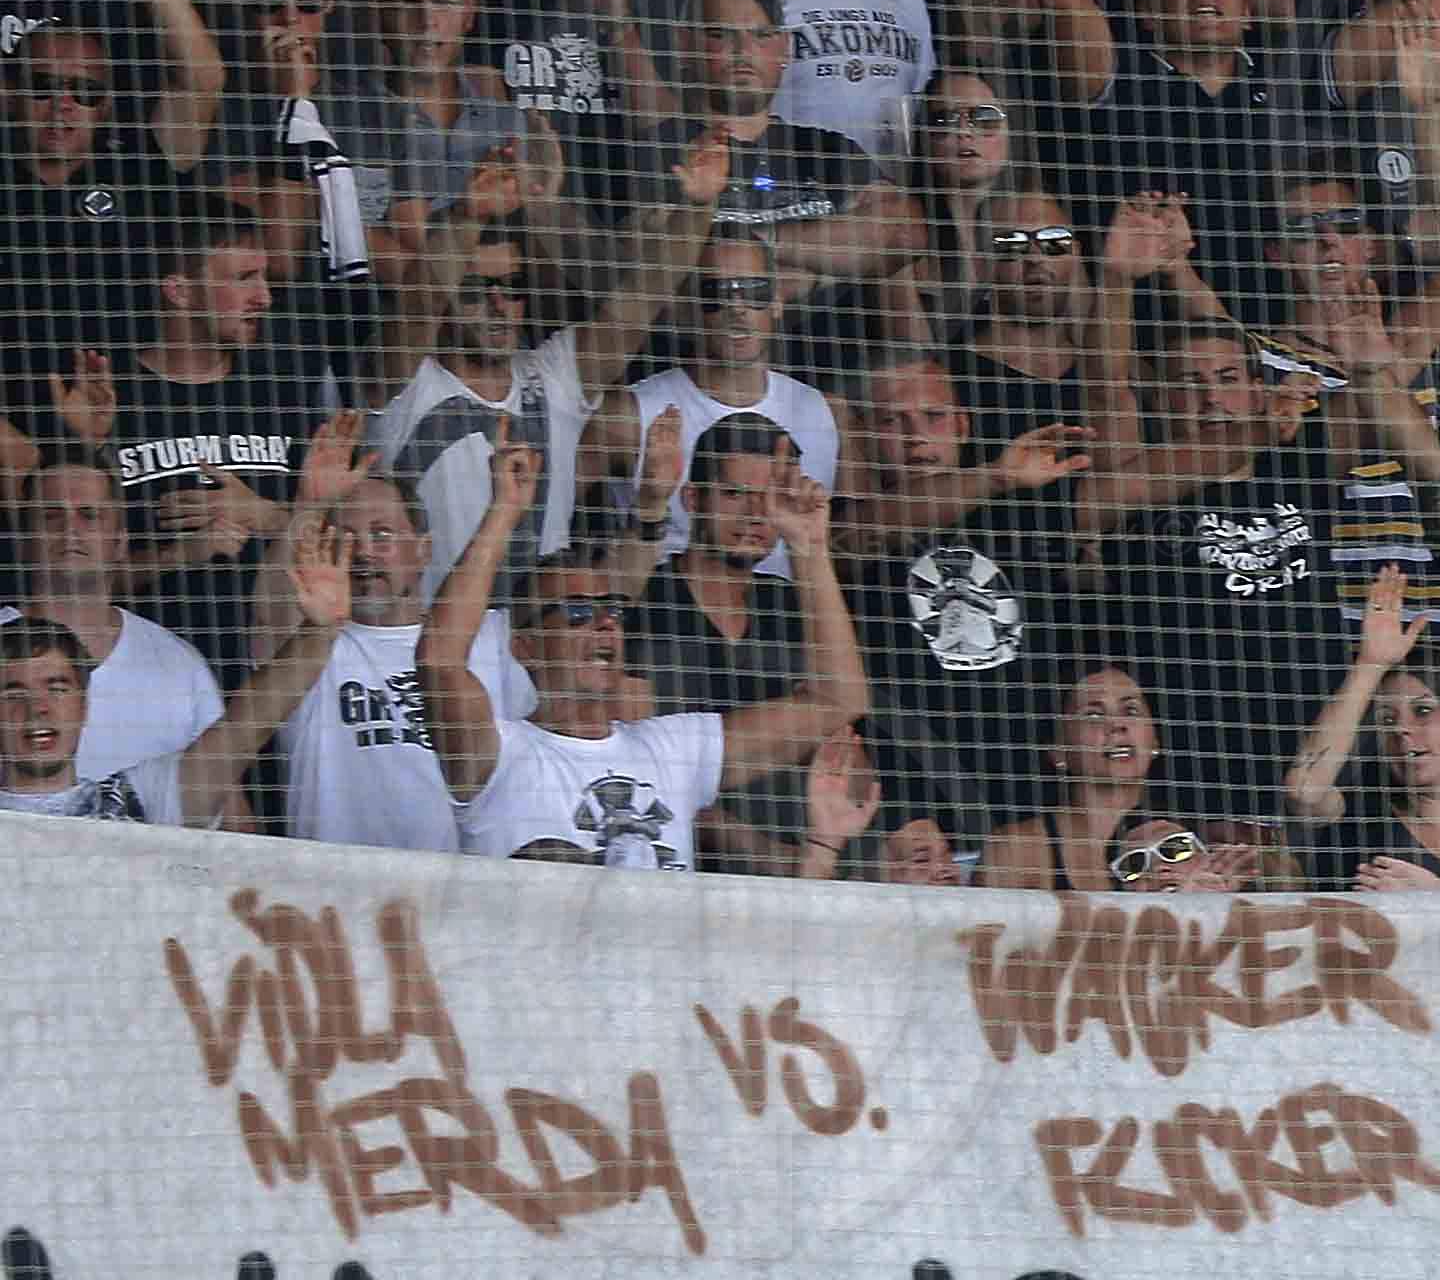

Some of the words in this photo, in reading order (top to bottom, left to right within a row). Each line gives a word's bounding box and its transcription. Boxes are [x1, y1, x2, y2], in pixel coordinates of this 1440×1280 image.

[119, 435, 225, 480] STURM
[958, 890, 1435, 1078] WACKER
[238, 1070, 708, 1257] MERDA
